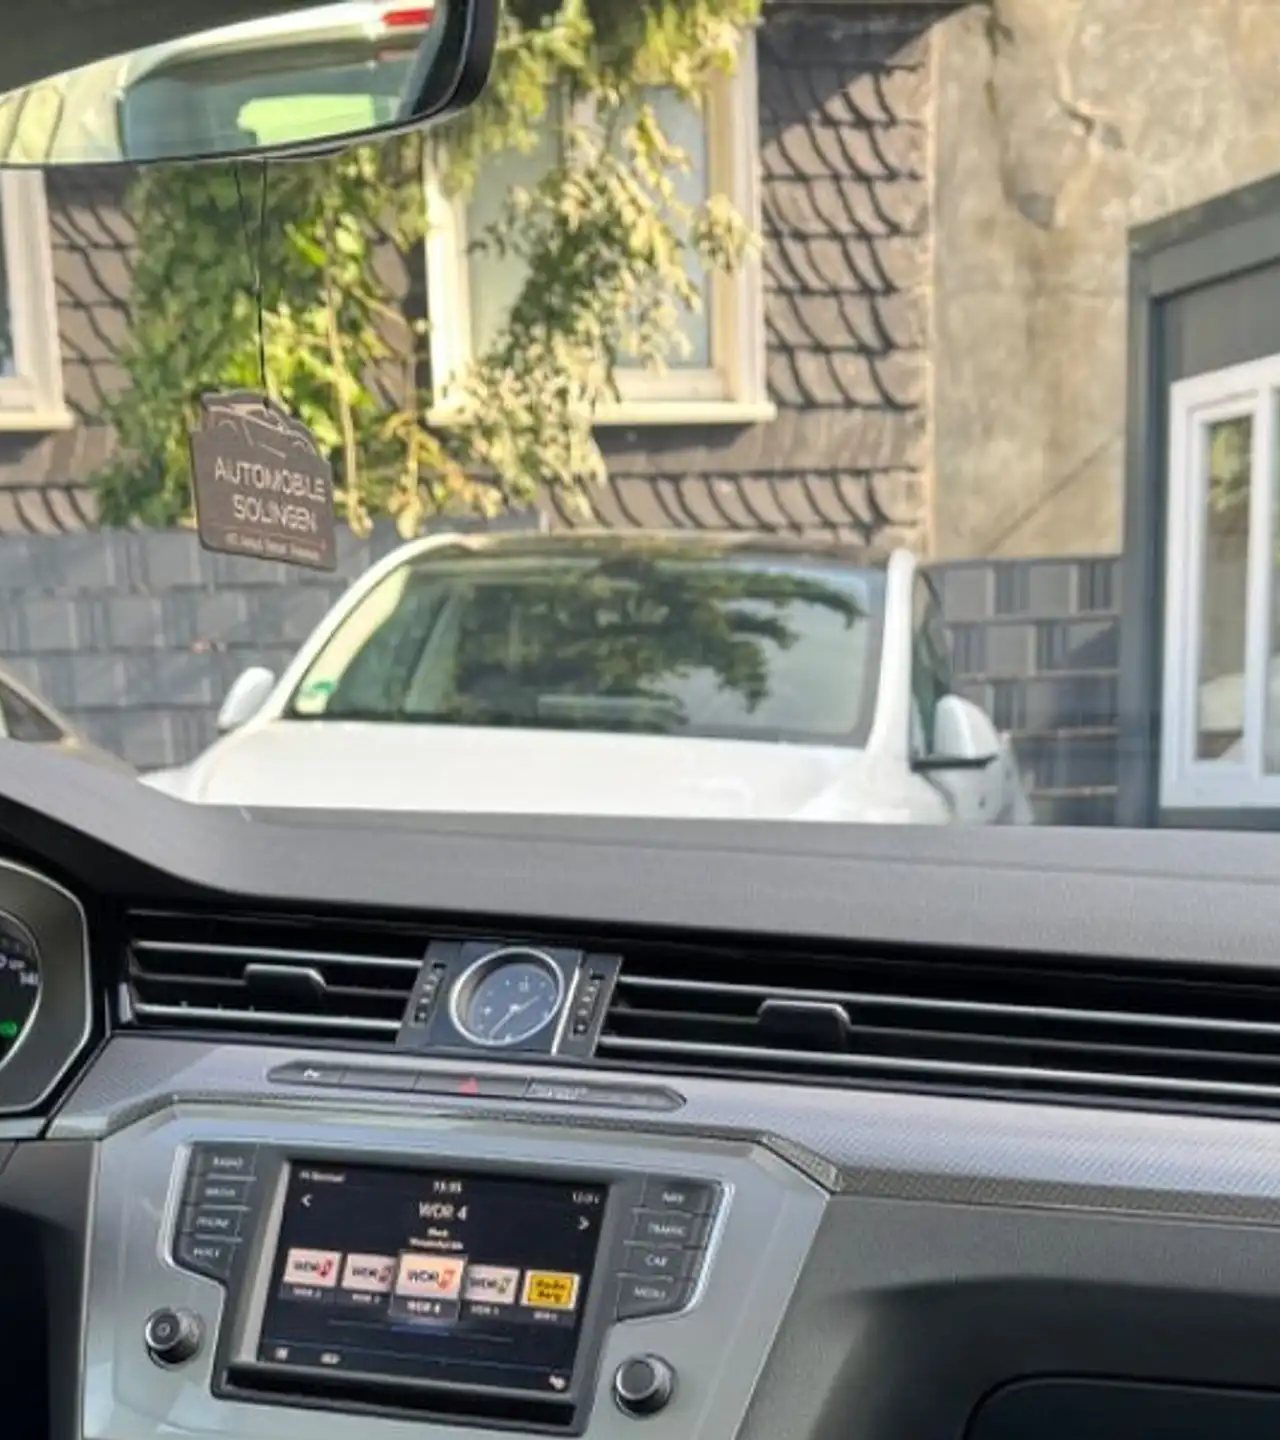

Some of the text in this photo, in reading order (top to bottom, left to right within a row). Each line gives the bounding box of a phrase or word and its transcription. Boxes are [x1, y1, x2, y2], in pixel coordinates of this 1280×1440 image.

[214, 456, 328, 504] AUTOMOBILE
[232, 493, 319, 534] SOLINGEN
[418, 1201, 469, 1221] WDR 4
